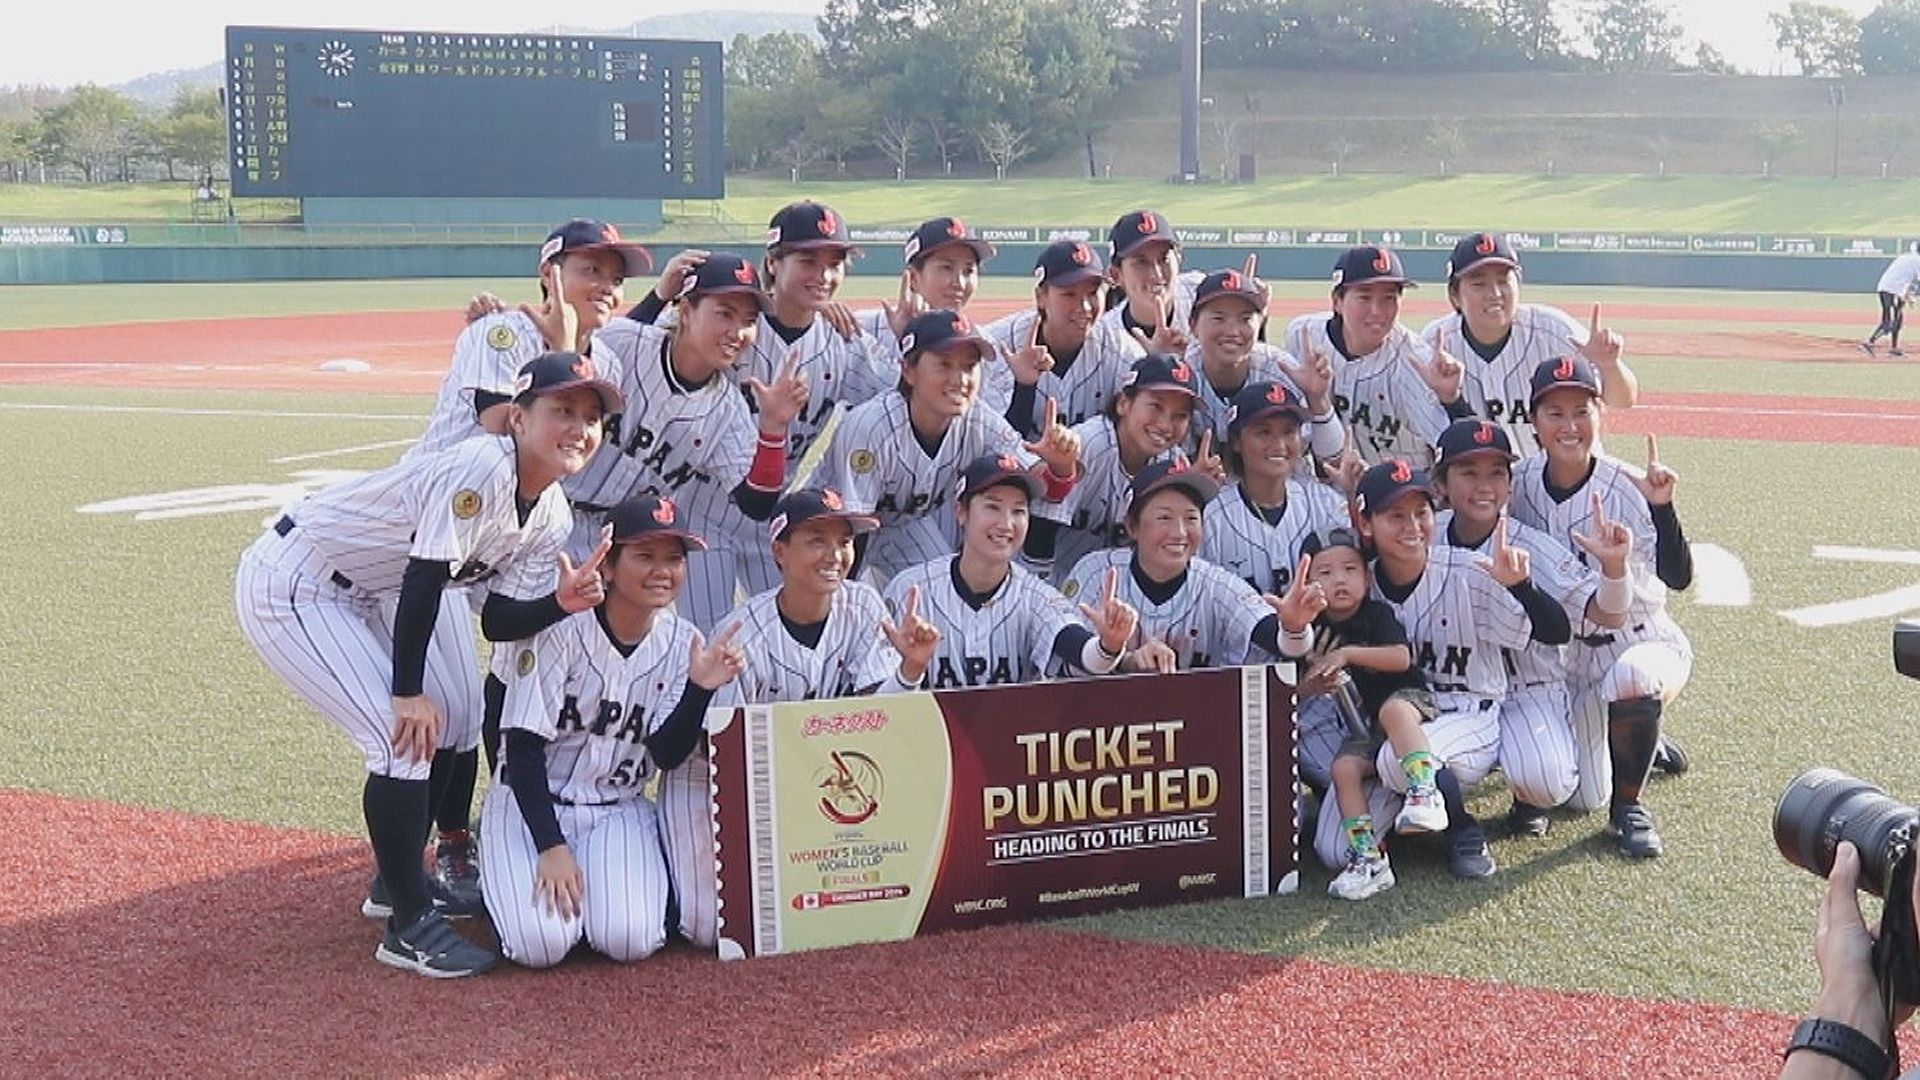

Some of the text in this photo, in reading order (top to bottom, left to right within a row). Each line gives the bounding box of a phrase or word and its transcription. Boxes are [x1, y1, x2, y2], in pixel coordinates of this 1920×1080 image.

[382, 35, 405, 45] TEAM
[983, 231, 1028, 241] KONAMI
[1334, 394, 1401, 437] PAN
[602, 412, 711, 491] APAN
[934, 657, 1012, 689] APA
[556, 694, 647, 745] APA
[1016, 719, 1185, 777] TICKET
[982, 765, 1220, 832] PUNCHED
[788, 840, 909, 864] WOMEN'S BASEBALL
[994, 817, 1209, 859] HEADING TO THE FINALS
[816, 854, 884, 872] WORLD CUP
